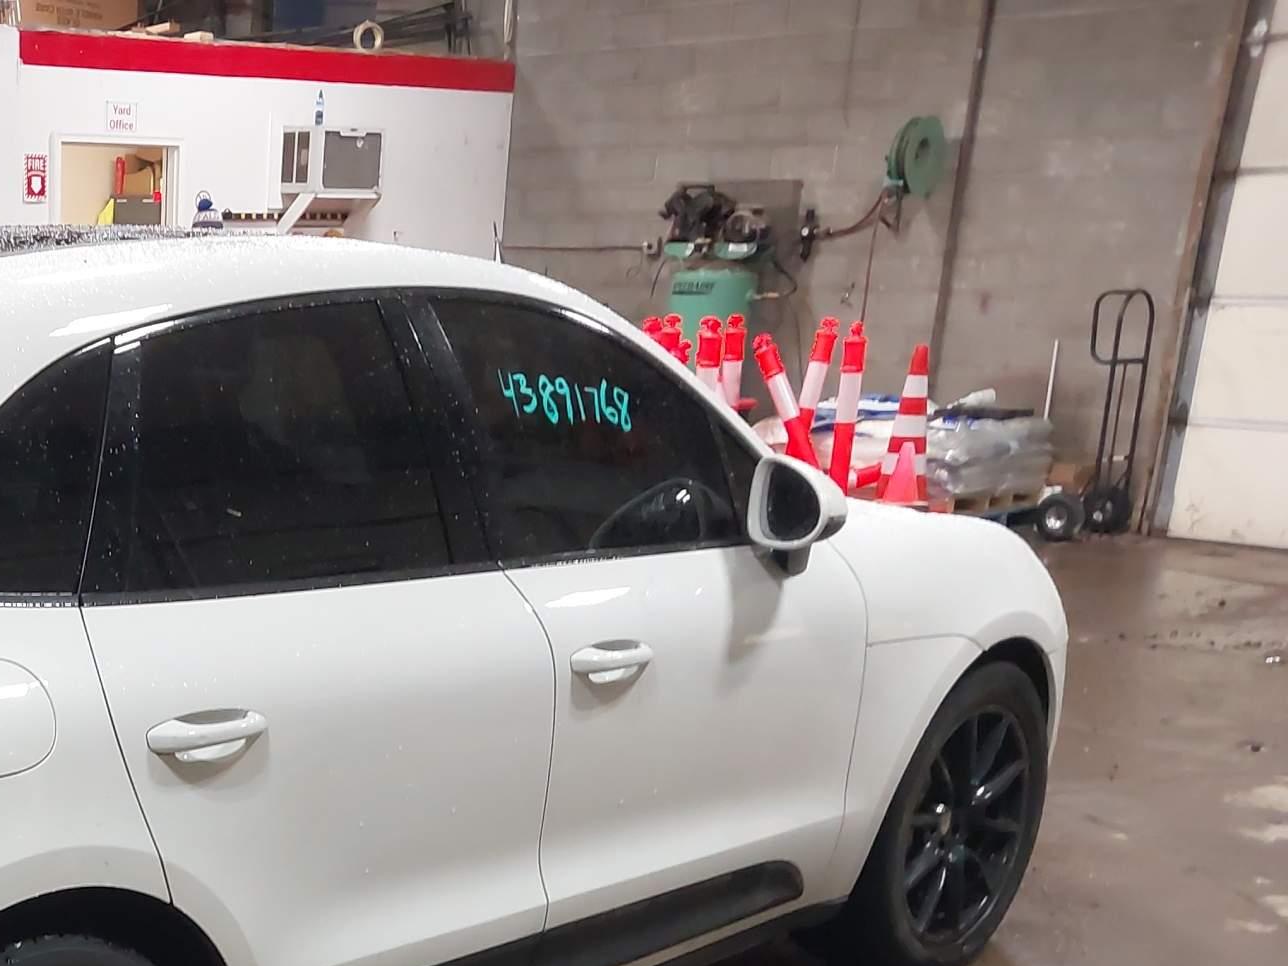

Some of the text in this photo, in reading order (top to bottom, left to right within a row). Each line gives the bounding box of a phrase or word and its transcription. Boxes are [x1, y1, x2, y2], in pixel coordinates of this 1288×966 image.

[112, 103, 132, 116] Yard
[109, 119, 134, 131] Office
[27, 158, 46, 171] FIRE
[498, 368, 632, 432] 43891768
